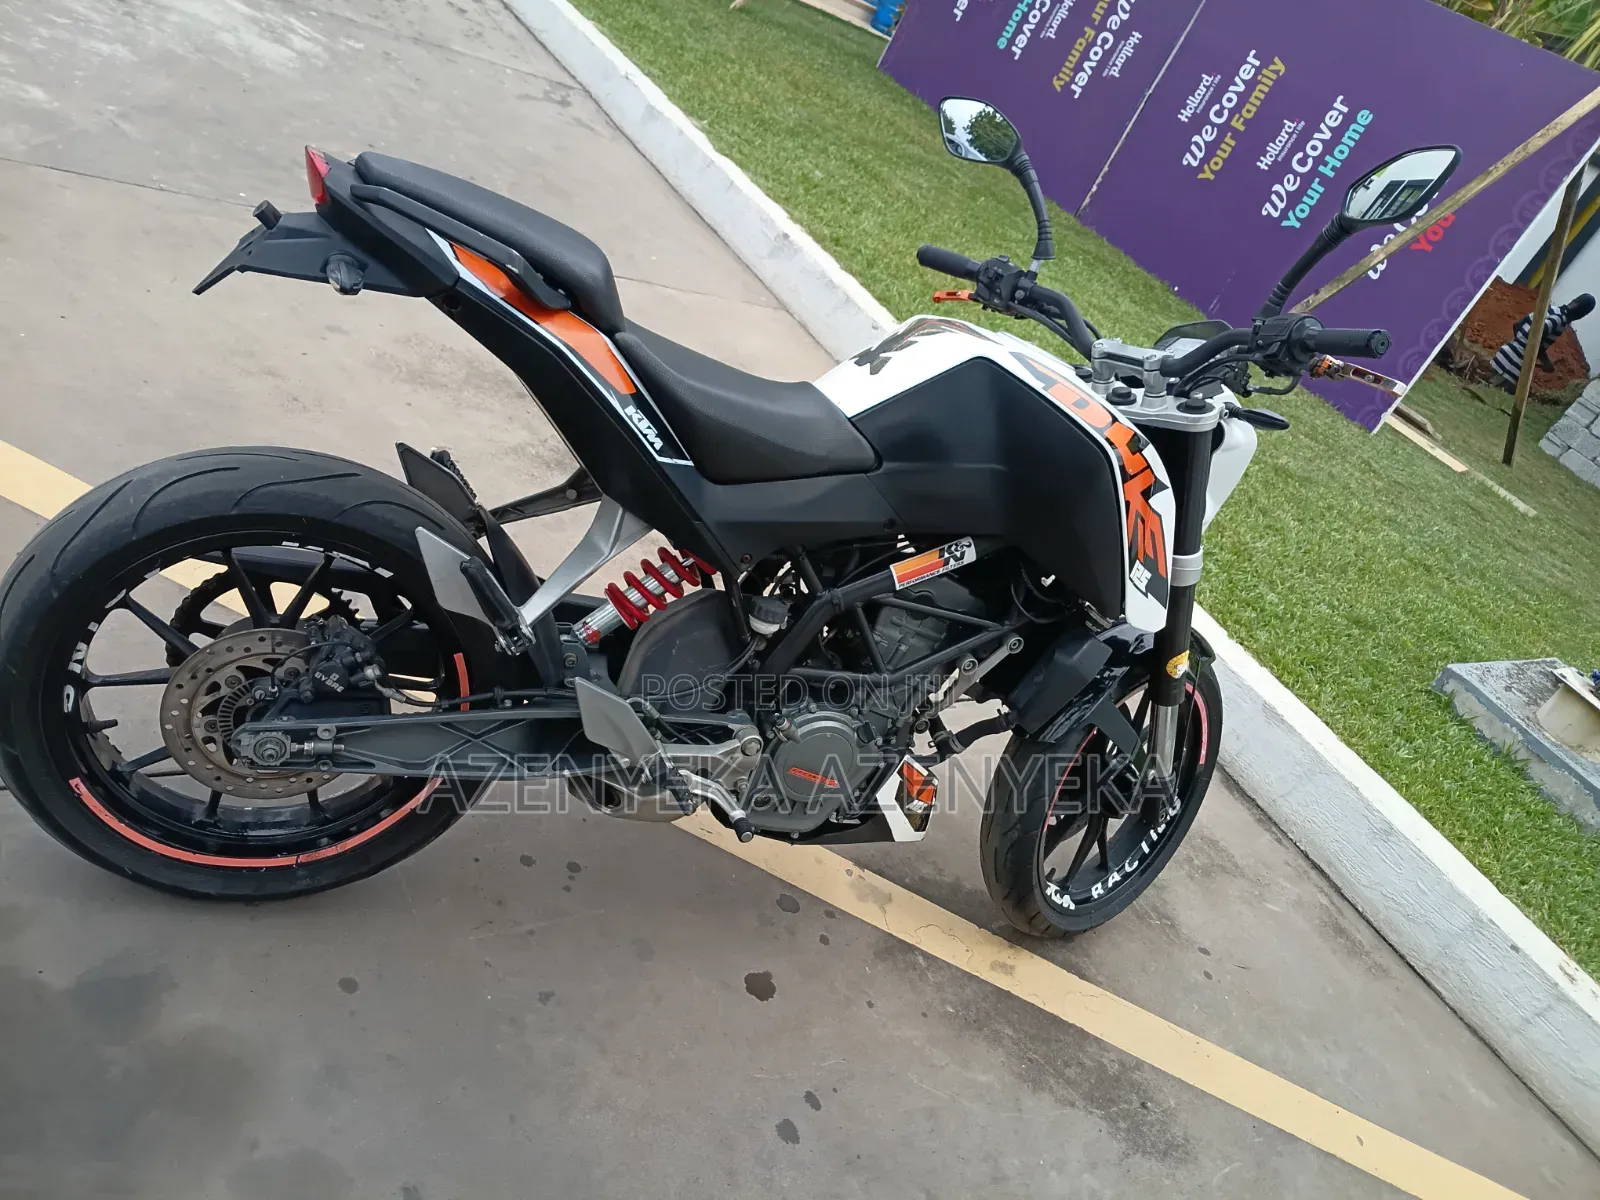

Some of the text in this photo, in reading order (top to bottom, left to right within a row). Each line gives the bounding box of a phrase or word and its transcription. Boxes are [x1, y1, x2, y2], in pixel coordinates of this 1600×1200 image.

[997, 0, 1032, 49] Home
[1012, 0, 1050, 60] Cover
[1053, 25, 1096, 92] Family
[1071, 31, 1114, 99] Cover
[1108, 31, 1142, 78] Hollard
[1178, 73, 1214, 122] Hollard
[1182, 50, 1260, 167] We Cover
[1197, 56, 1285, 180] Your Family
[1256, 119, 1297, 170] Hollard
[1262, 95, 1349, 217] We Cover
[1277, 133, 1298, 161] insurance
[1280, 109, 1374, 229] Your Home
[624, 405, 663, 450] KTM
[898, 560, 965, 588] PERFORMANCE FILTERS
[939, 540, 972, 567] K&N
[314, 671, 345, 693] BYBRE
